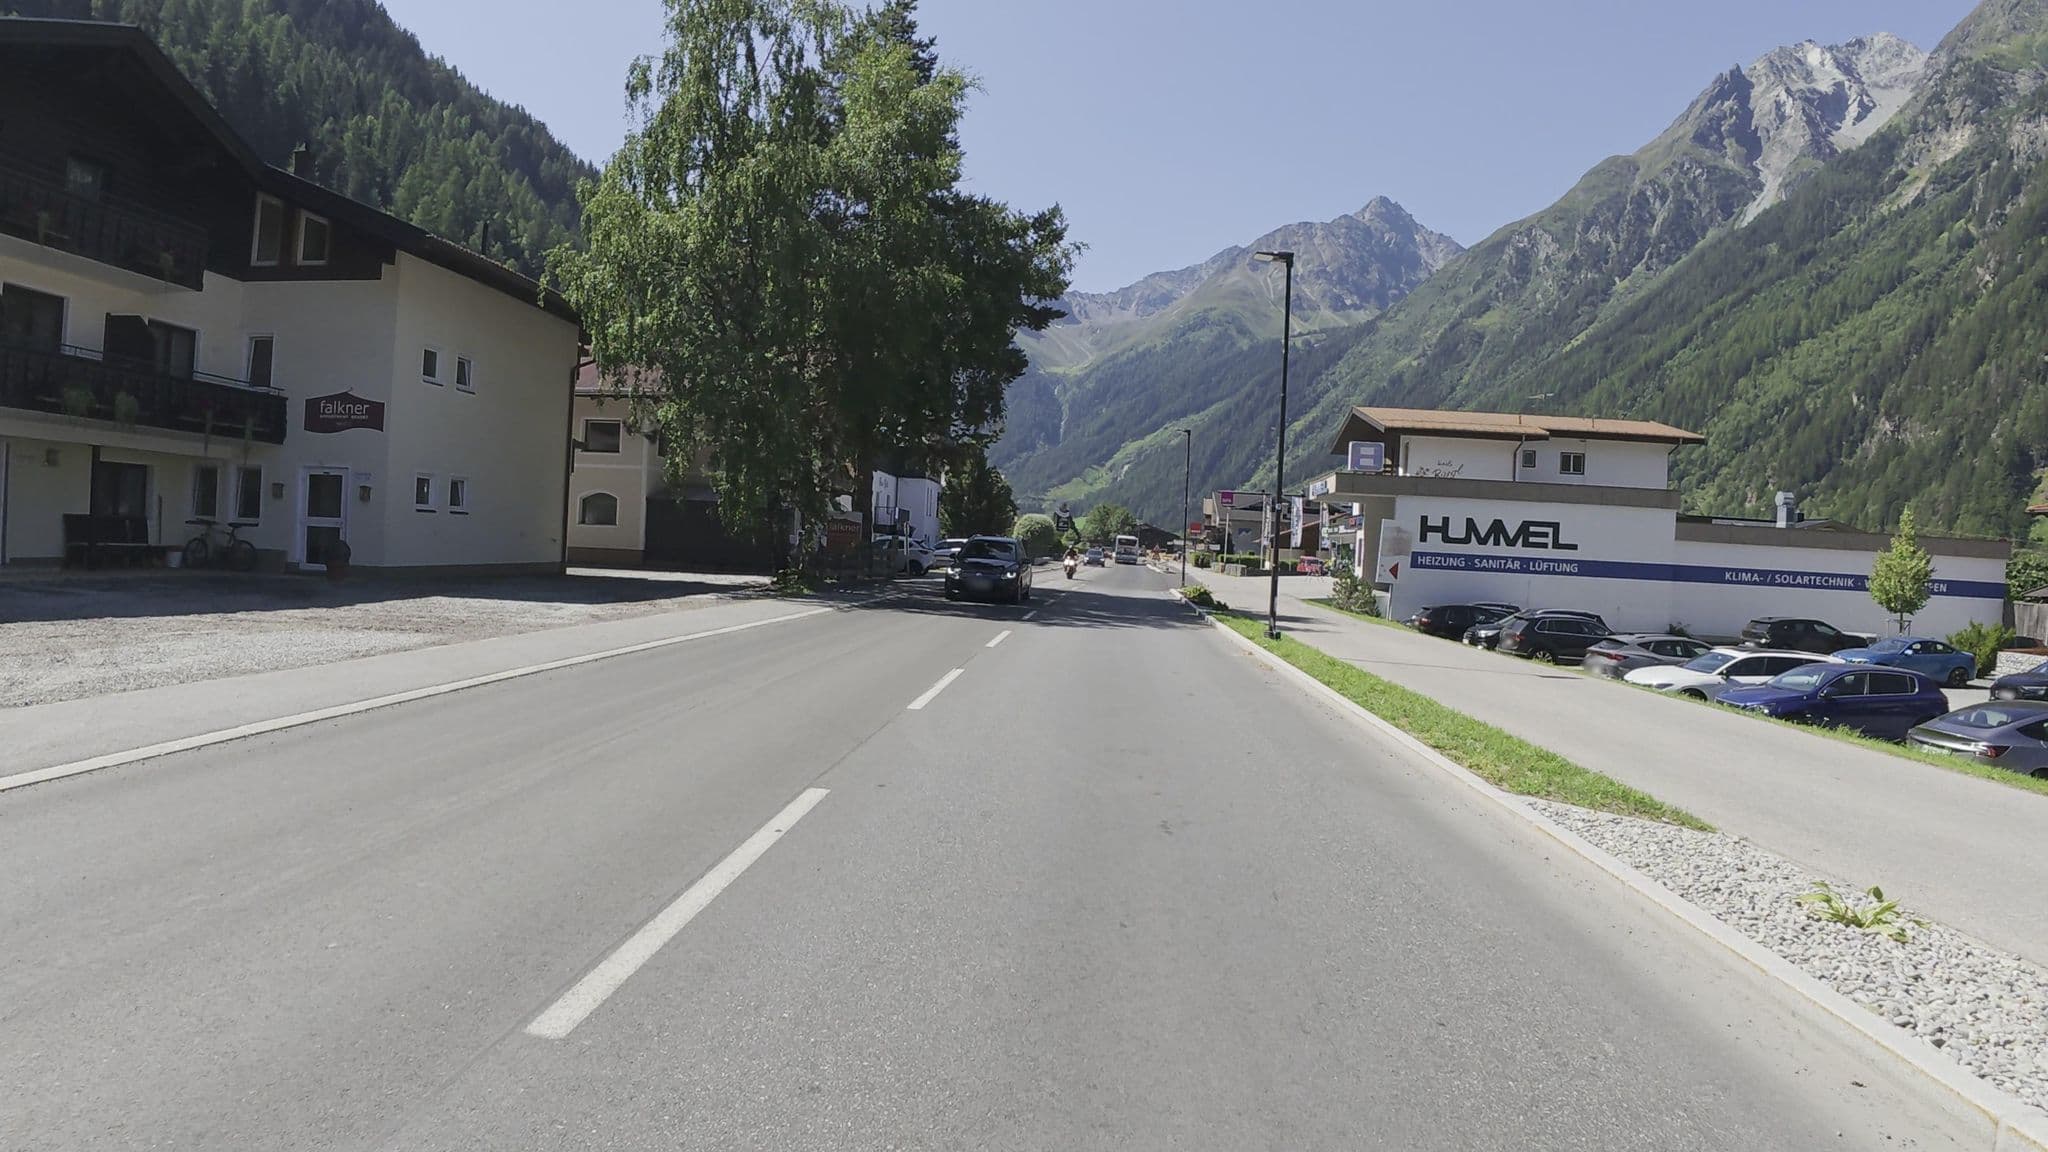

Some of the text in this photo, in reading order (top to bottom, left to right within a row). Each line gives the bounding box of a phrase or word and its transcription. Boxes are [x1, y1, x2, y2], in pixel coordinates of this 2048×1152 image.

[320, 400, 370, 415] falkner
[1419, 515, 1579, 550] HUMMEL
[1417, 556, 1579, 573] HEIZUNG SANITÄR LÜFTUNG
[1724, 571, 1764, 582] KLIMA-
[1774, 573, 1855, 587] SOLARTECHNIK
